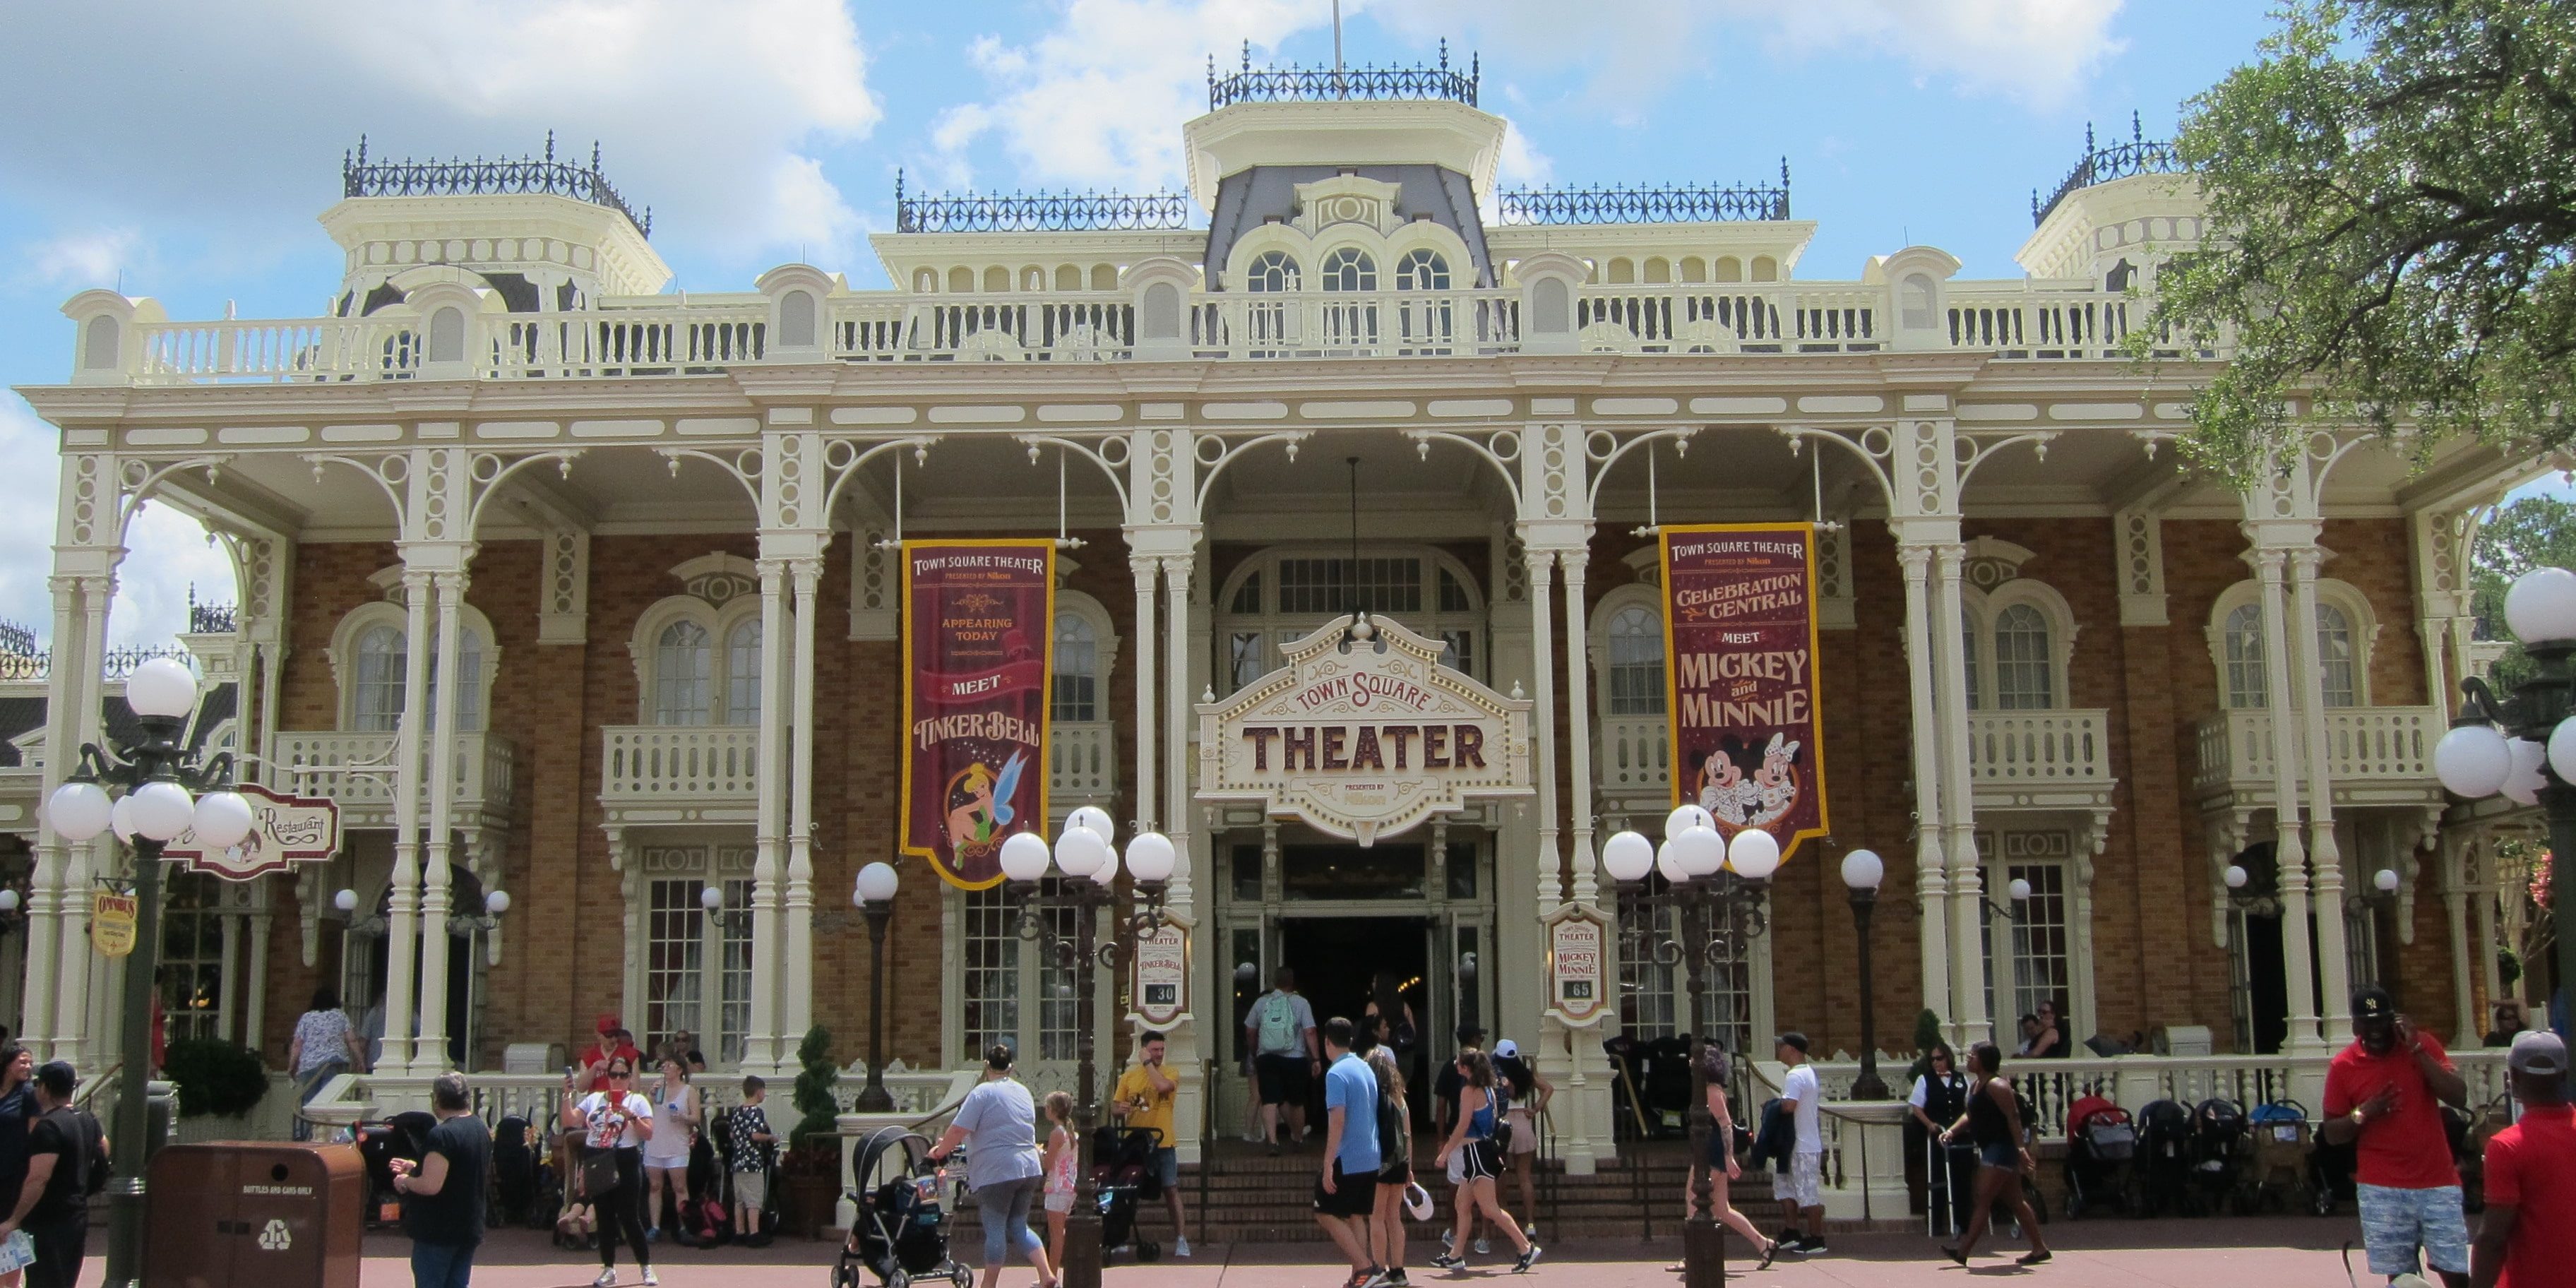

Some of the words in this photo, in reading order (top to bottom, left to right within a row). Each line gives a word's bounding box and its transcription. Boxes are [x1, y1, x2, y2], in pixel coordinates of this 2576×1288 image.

[1671, 543, 1704, 561] TOWN
[1707, 542, 1751, 554] SQUARE
[1753, 542, 1803, 560] THEATER
[914, 557, 946, 576] TOWN
[948, 556, 991, 567] SQUARE
[994, 556, 1043, 575] THEATER
[1676, 573, 1801, 607] CELEBRATION
[1709, 590, 1802, 619] CENTRAL
[942, 619, 1013, 629] APPEARING
[955, 631, 998, 641] TODAY
[1722, 631, 1760, 644] MEET
[1680, 649, 1807, 688] MICKEY
[952, 674, 1001, 696] MEET
[1296, 678, 1349, 710] TOWN
[1352, 672, 1431, 711] SQUARE
[1731, 681, 1758, 697] and
[1682, 689, 1809, 727] MINNIE
[913, 714, 984, 752] TINKER
[985, 711, 1039, 747] BELL
[1242, 724, 1487, 770] THEATER
[258, 807, 324, 846] Restaurant
[99, 896, 135, 918] OMNIBUS
[1140, 960, 1163, 971] TINKER
[1558, 953, 1596, 963] MICKEY
[1558, 964, 1596, 974] MINNIE
[1158, 986, 1173, 1000] 30
[1573, 984, 1589, 996] 65
[243, 1185, 268, 1194] BOTTLES
[270, 1186, 281, 1194] AND
[297, 1186, 313, 1195] ONLY
